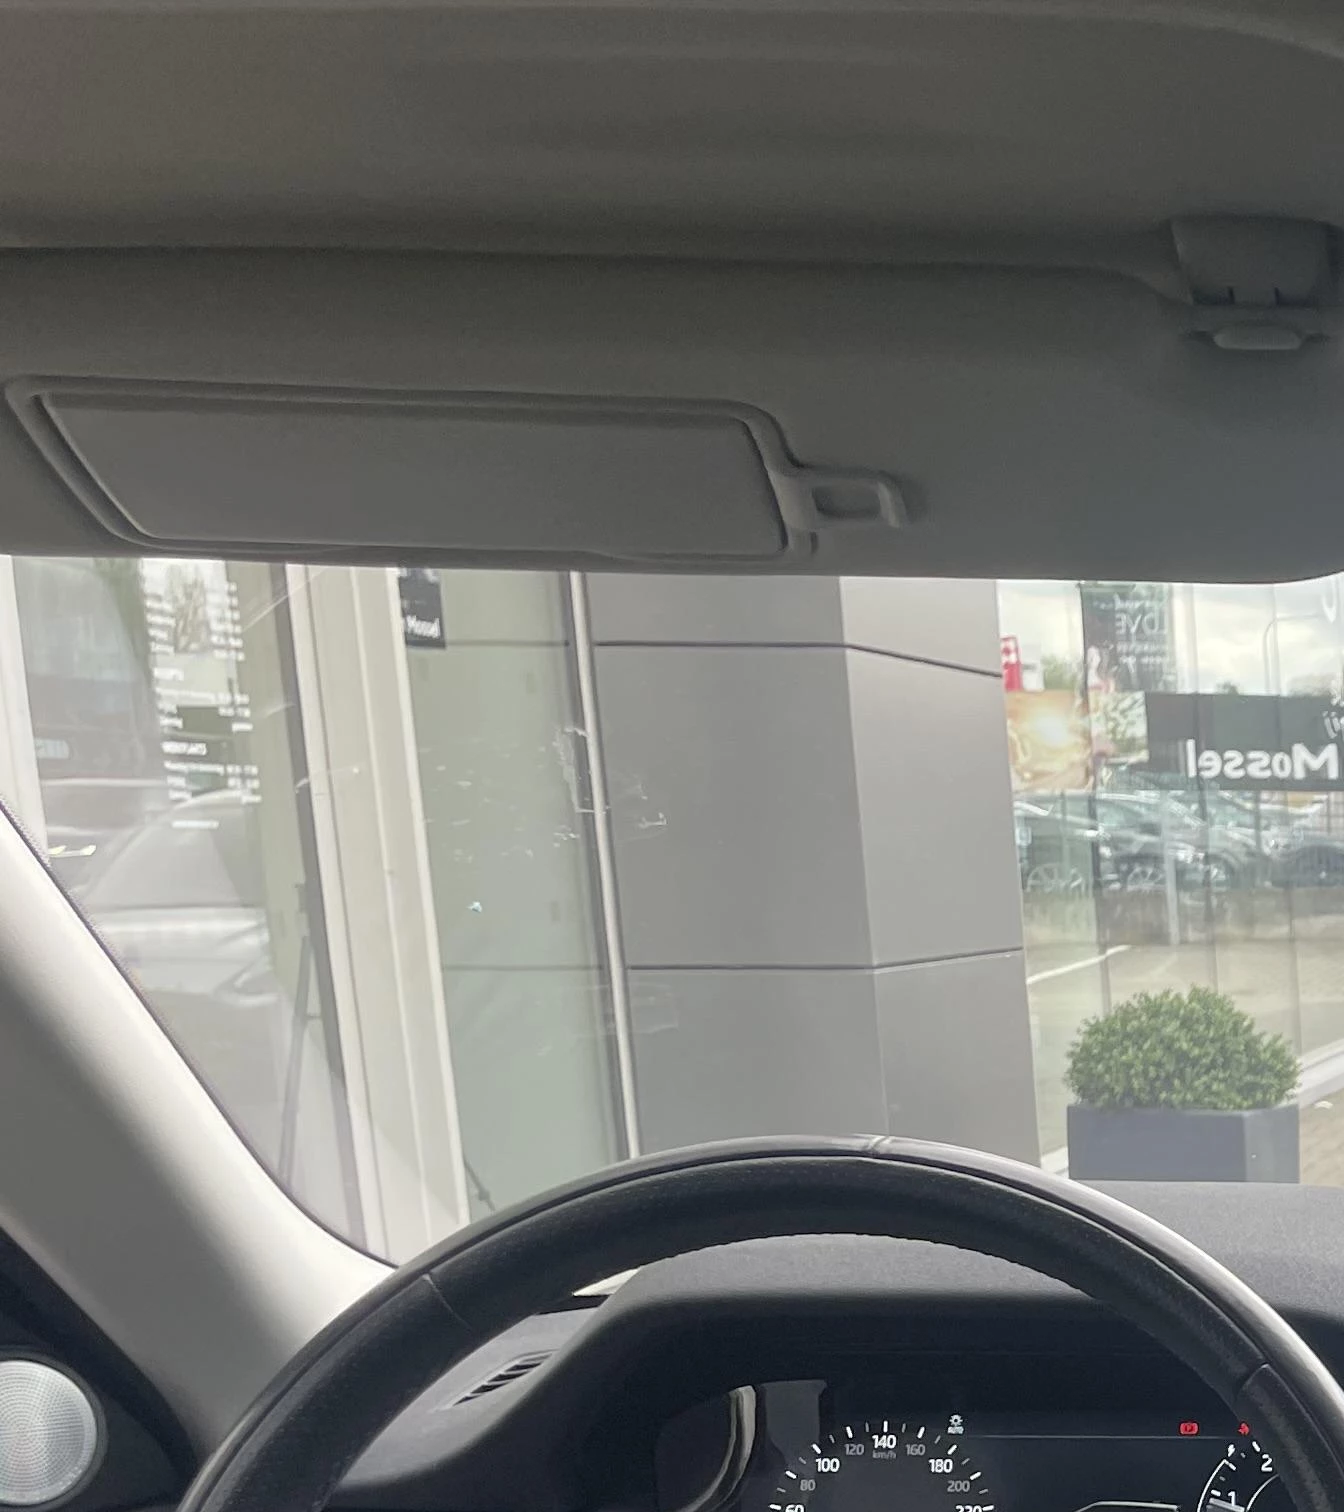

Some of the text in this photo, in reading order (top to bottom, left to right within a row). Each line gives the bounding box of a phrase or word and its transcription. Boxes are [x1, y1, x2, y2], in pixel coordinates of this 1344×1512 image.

[872, 1435, 897, 1449] 140
[845, 1444, 864, 1455] 120
[872, 1451, 896, 1460] km/h
[906, 1444, 925, 1455] 160
[816, 1458, 840, 1472] 100
[928, 1459, 953, 1473] 180
[1261, 1454, 1273, 1472] 2
[800, 1480, 816, 1491] 80
[947, 1480, 971, 1492] 200
